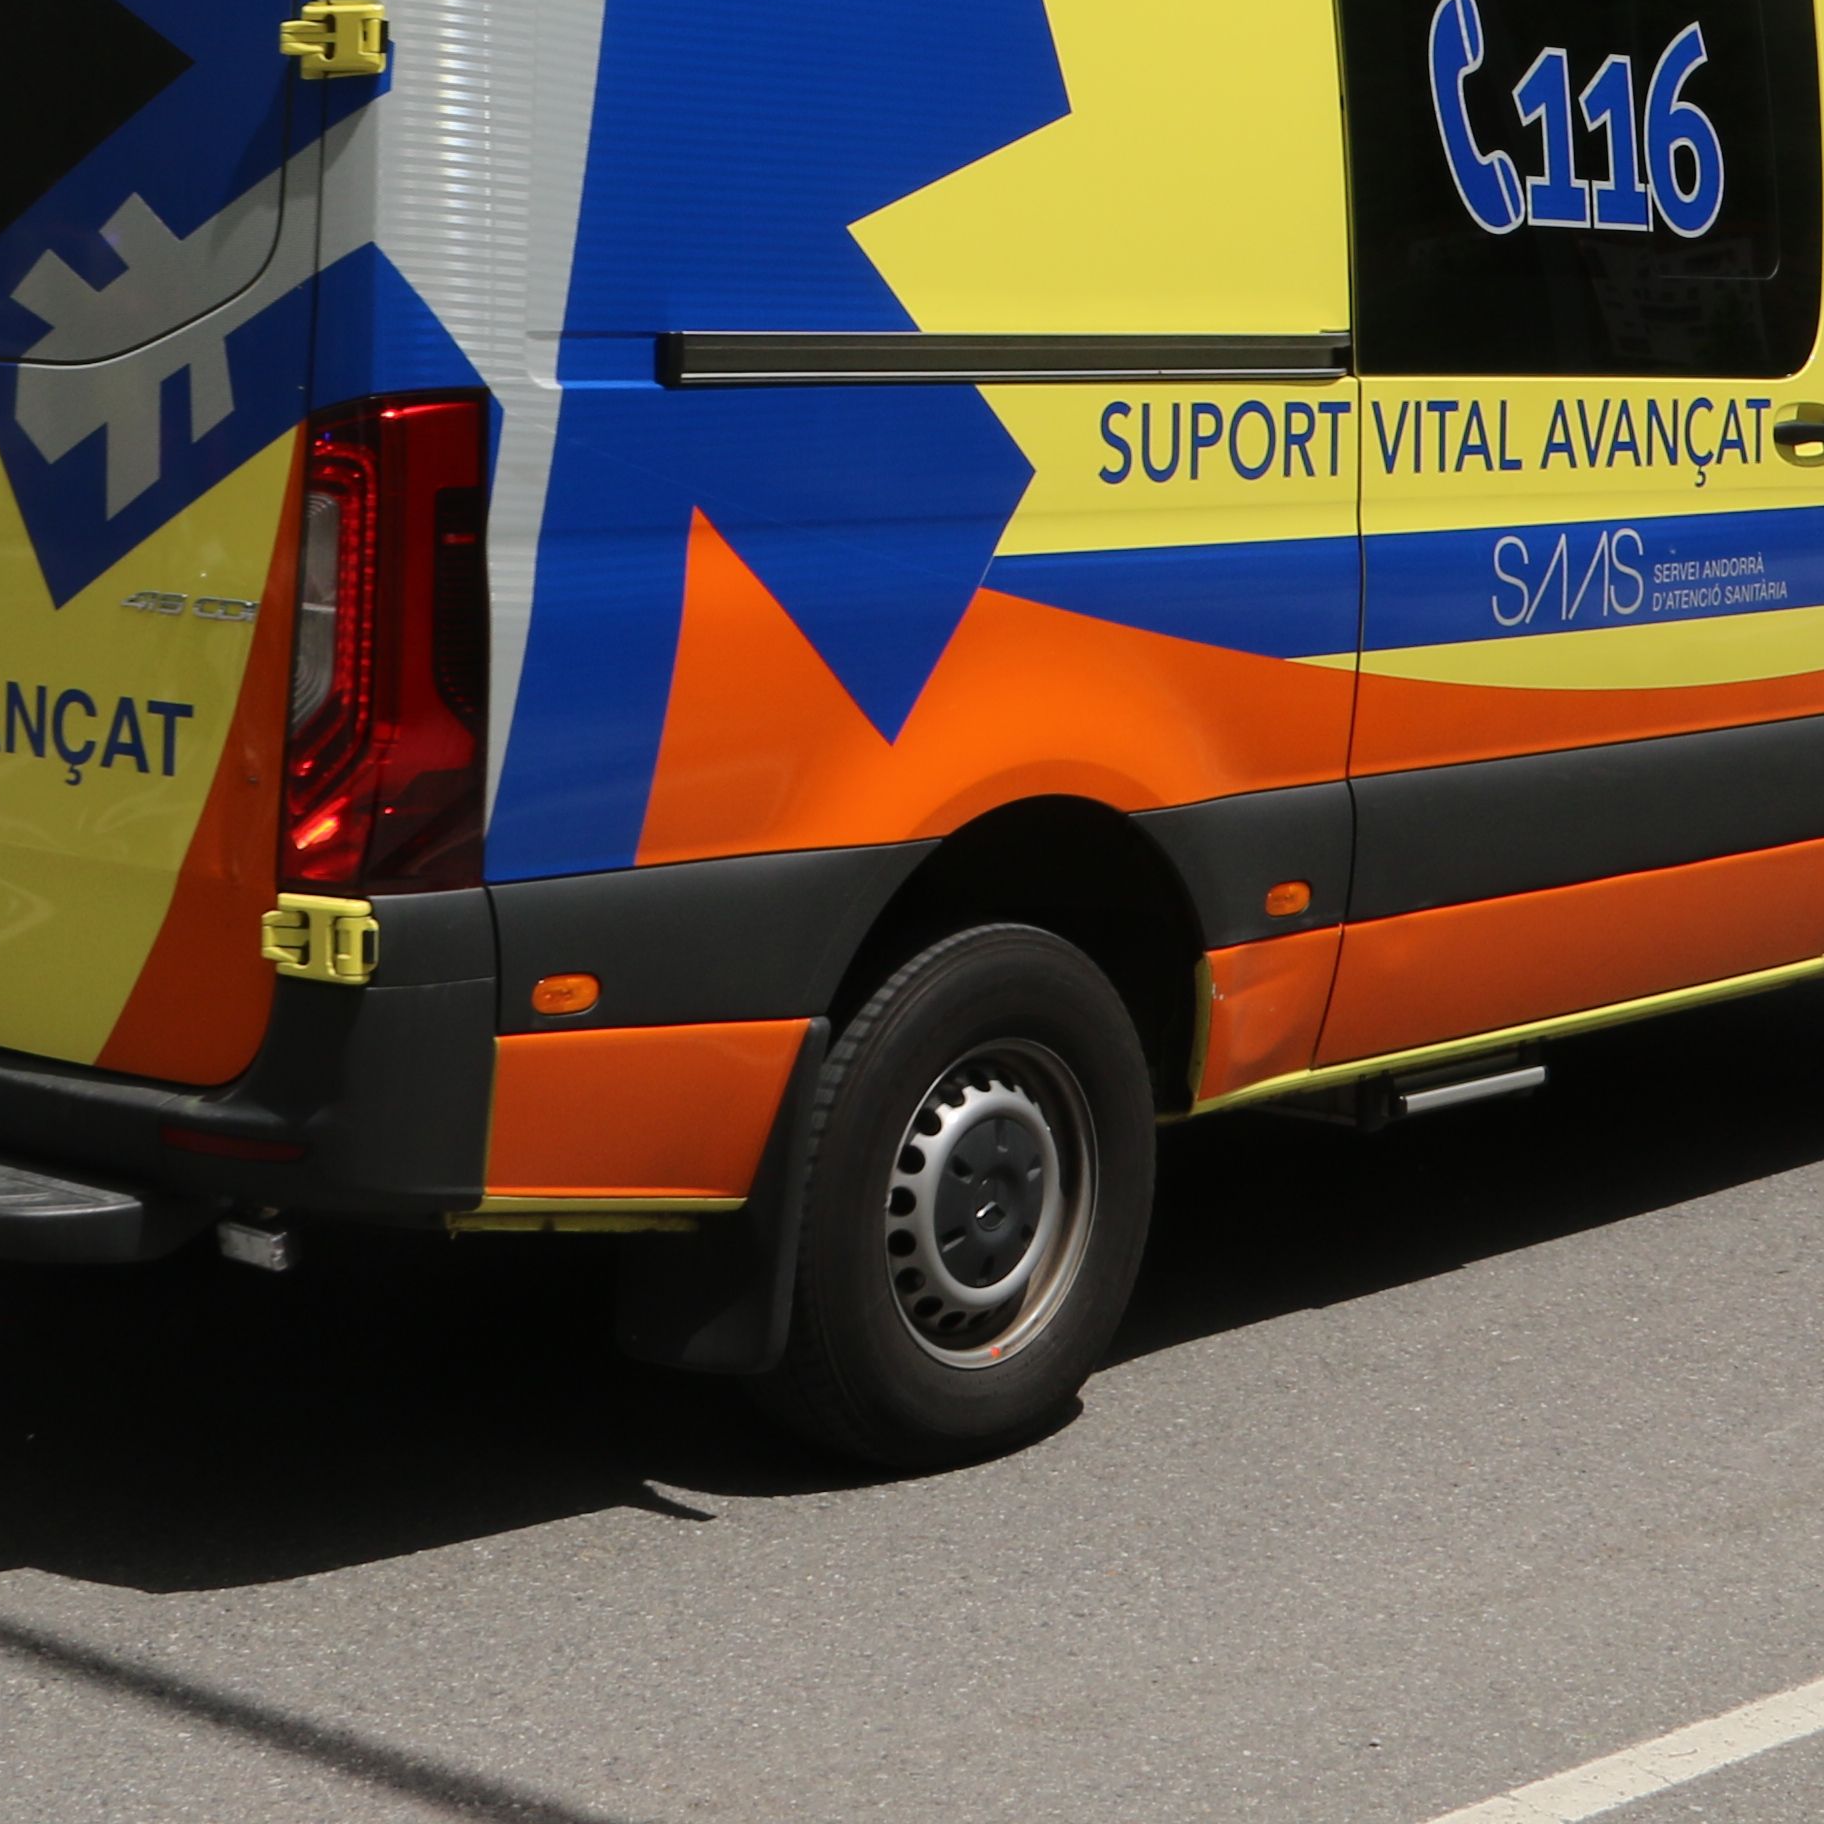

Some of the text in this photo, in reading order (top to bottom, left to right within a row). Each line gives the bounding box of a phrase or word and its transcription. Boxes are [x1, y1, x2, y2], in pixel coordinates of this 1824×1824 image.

[1512, 20, 1725, 239] 116
[1098, 396, 1773, 487] SUPORT VITAL AVANÇAT
[1652, 578, 1788, 612] D'ATENCIÓ SANITÀRIA
[1654, 551, 1764, 584] SERVEI ANDORRÀ
